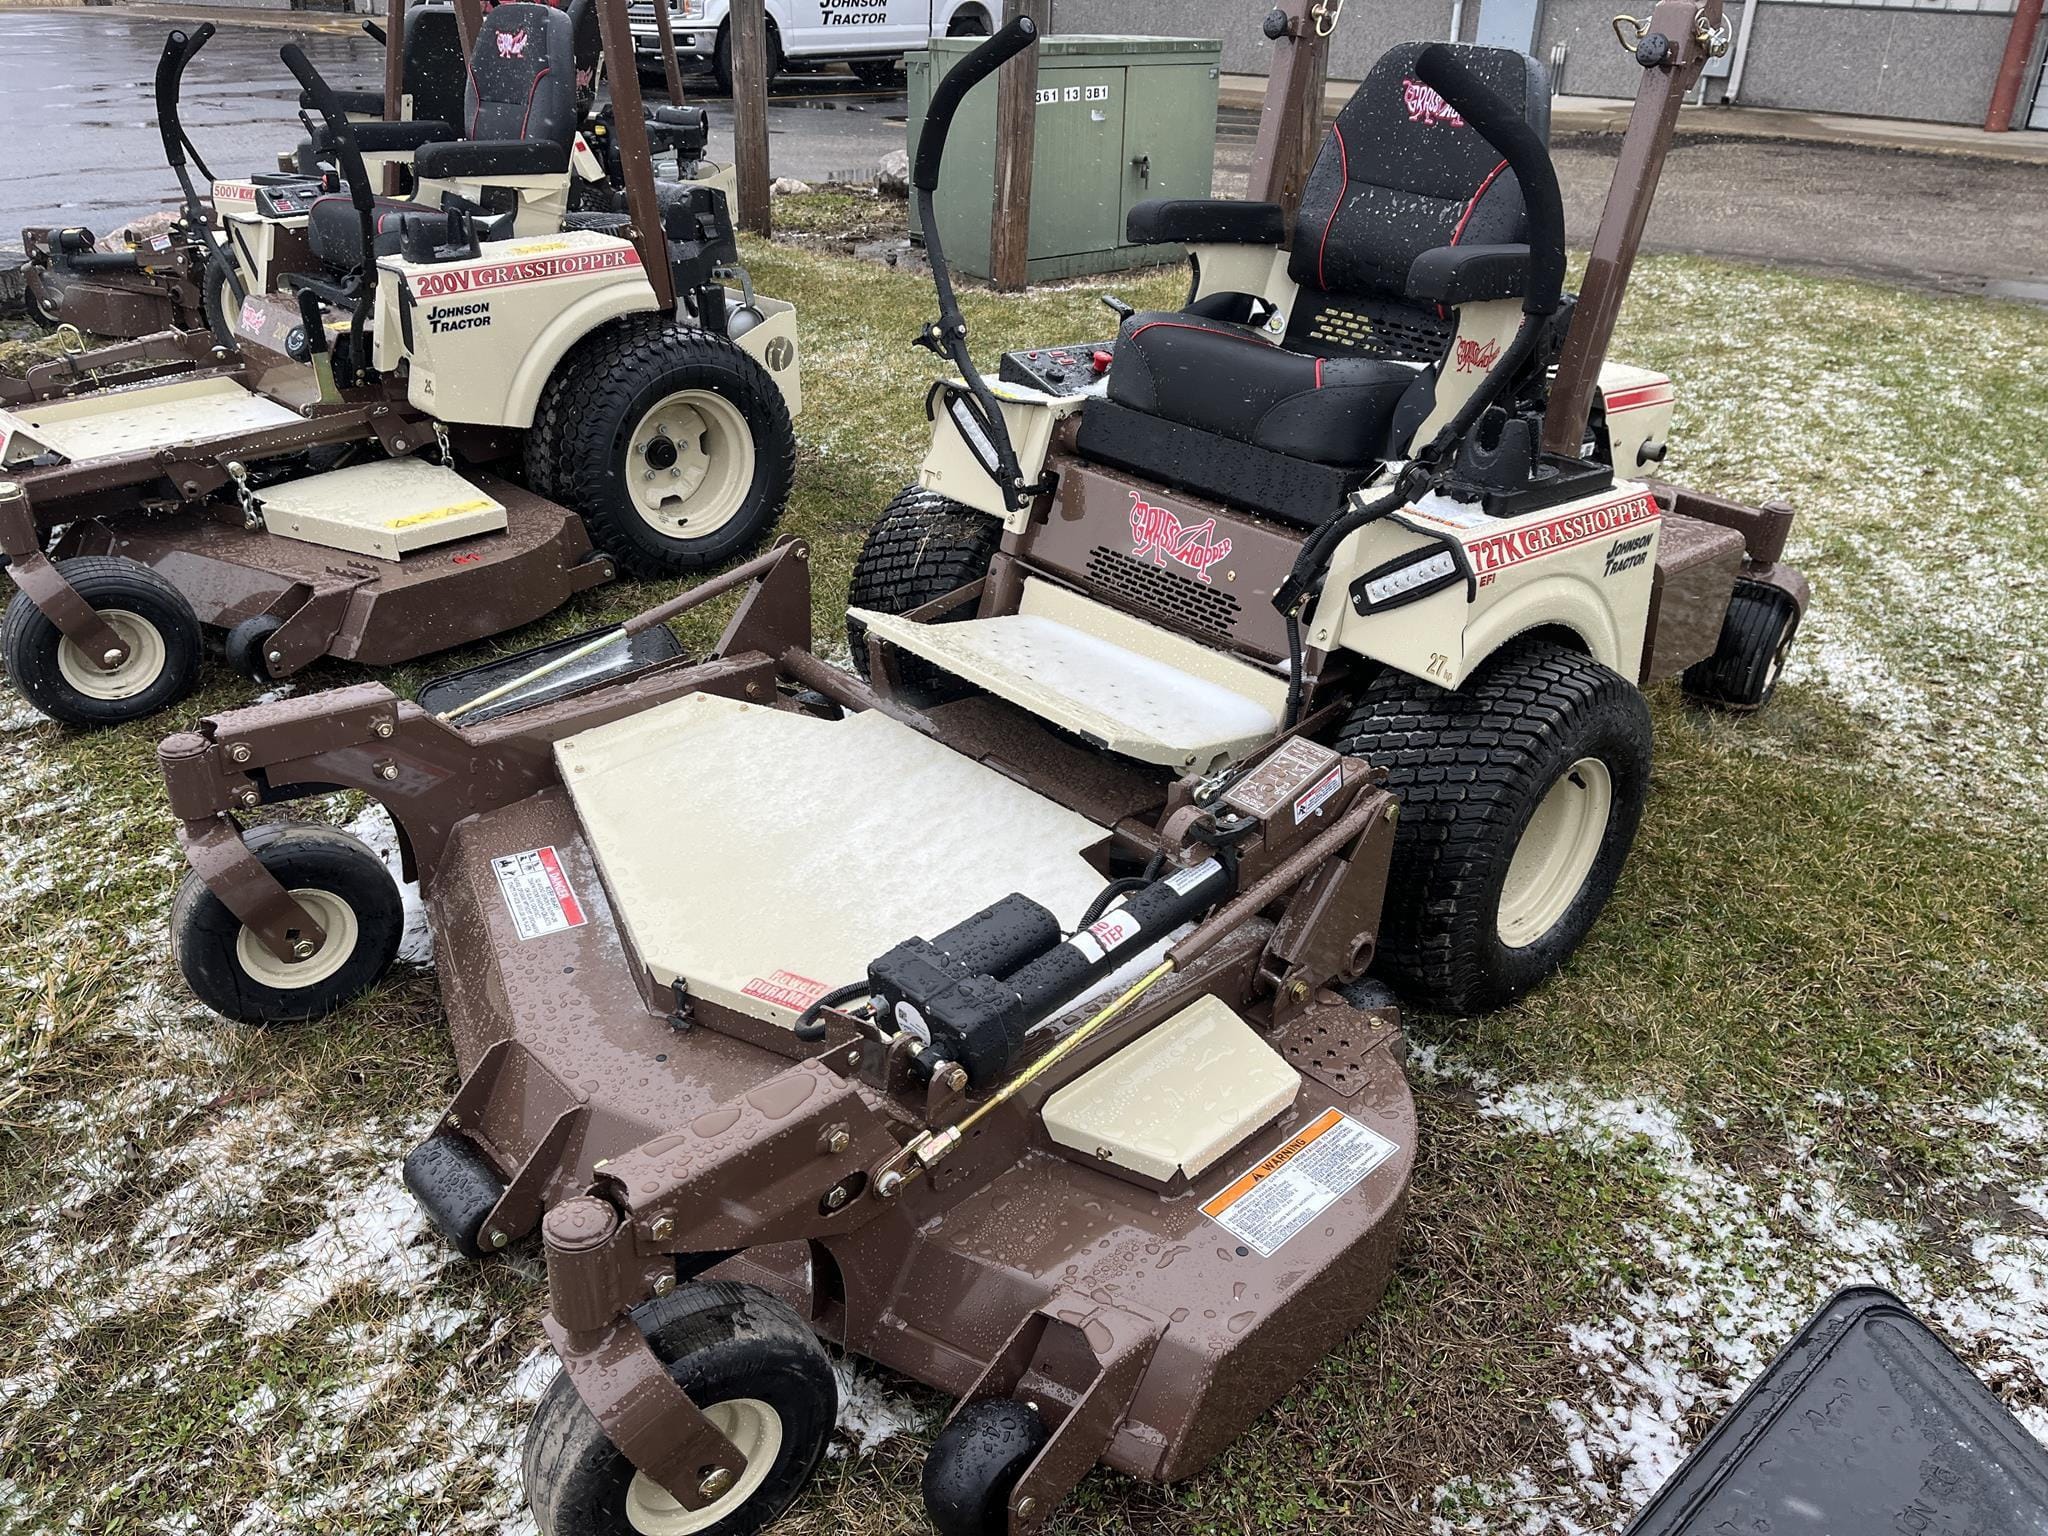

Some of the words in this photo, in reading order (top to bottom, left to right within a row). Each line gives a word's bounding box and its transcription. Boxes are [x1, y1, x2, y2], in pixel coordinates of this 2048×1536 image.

[822, 10, 887, 25] TRACTOR
[1066, 89, 1078, 99] 13
[1086, 87, 1106, 99] 3B1
[214, 185, 238, 198] 500V
[417, 270, 470, 296] 200V
[478, 250, 627, 286] GRASSHOPPER
[427, 302, 490, 321] JOHNSON
[430, 316, 491, 334] TRACTOR
[1468, 533, 1524, 572] 727K
[1524, 498, 1651, 553] GRASSHOPPER
[1606, 533, 1654, 560] JOHNSON
[1603, 551, 1648, 578] TRACTOR
[1479, 573, 1497, 588] EFI
[1425, 652, 1449, 678] 27
[549, 871, 570, 899] DANGER
[1091, 921, 1109, 935] NO
[1101, 925, 1123, 947] TEP
[1261, 1137, 1307, 1171] WARNING
